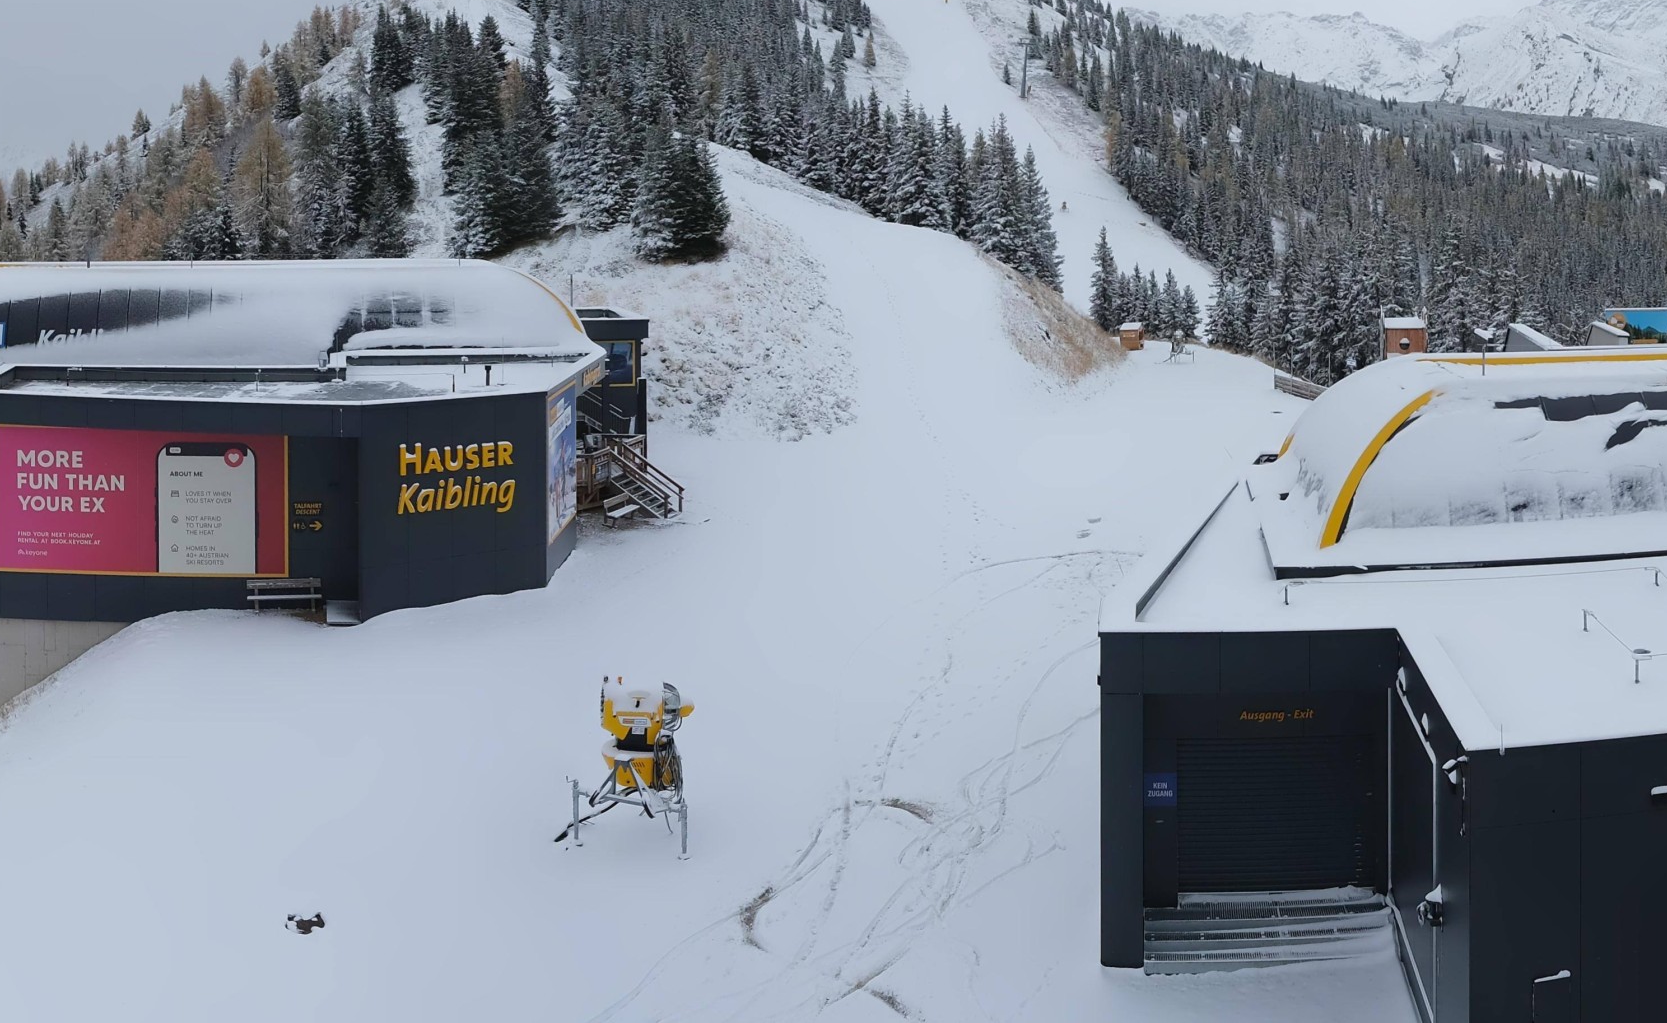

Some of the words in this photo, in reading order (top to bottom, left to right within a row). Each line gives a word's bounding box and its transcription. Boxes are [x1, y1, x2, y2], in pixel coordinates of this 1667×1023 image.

[17, 449, 83, 468] MORE
[399, 441, 514, 476] HAUSER
[17, 473, 58, 490] FUN
[65, 474, 125, 491] THAN
[18, 495, 73, 512] YOUR
[80, 497, 105, 513] EX
[397, 475, 516, 515] Kaibling
[1240, 710, 1285, 722] Ausgang
[1293, 709, 1314, 719] Exit
